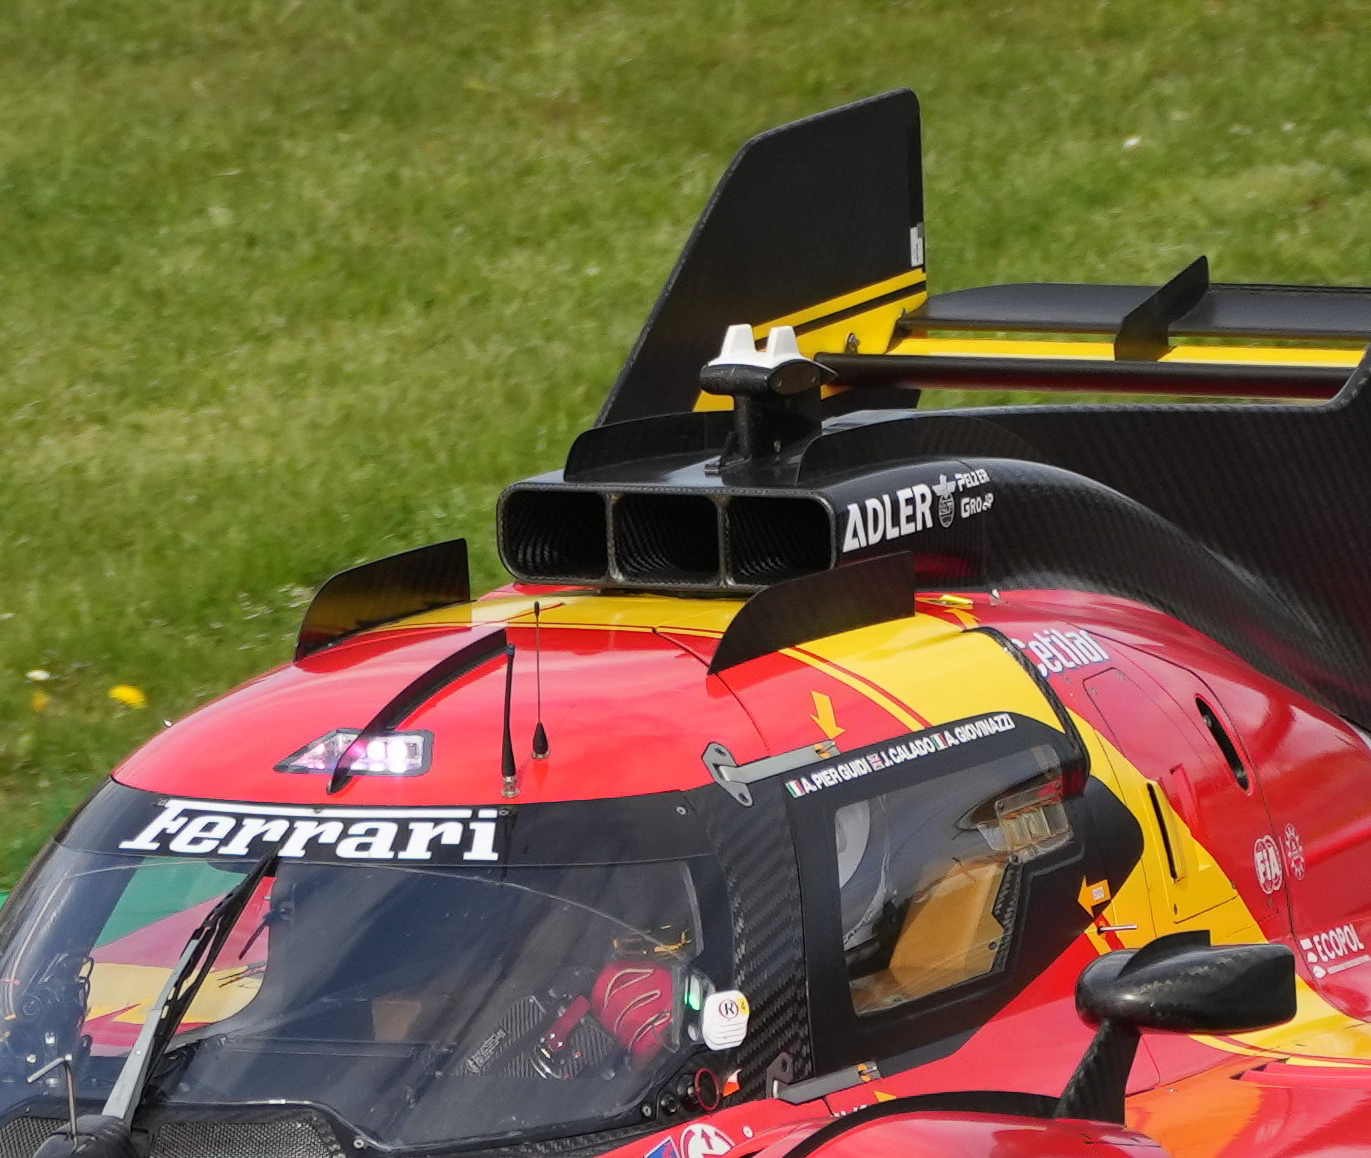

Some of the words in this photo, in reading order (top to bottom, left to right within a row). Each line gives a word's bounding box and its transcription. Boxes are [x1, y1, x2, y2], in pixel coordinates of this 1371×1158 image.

[955, 468, 990, 492] PELZER
[842, 483, 933, 553] ADLER
[955, 712, 1016, 743] GIOVINAZZI
[887, 736, 936, 764] CALADO
[837, 757, 872, 781] GUIDI
[118, 800, 500, 861] Ferrari
[1312, 922, 1365, 963] ECOPOL
